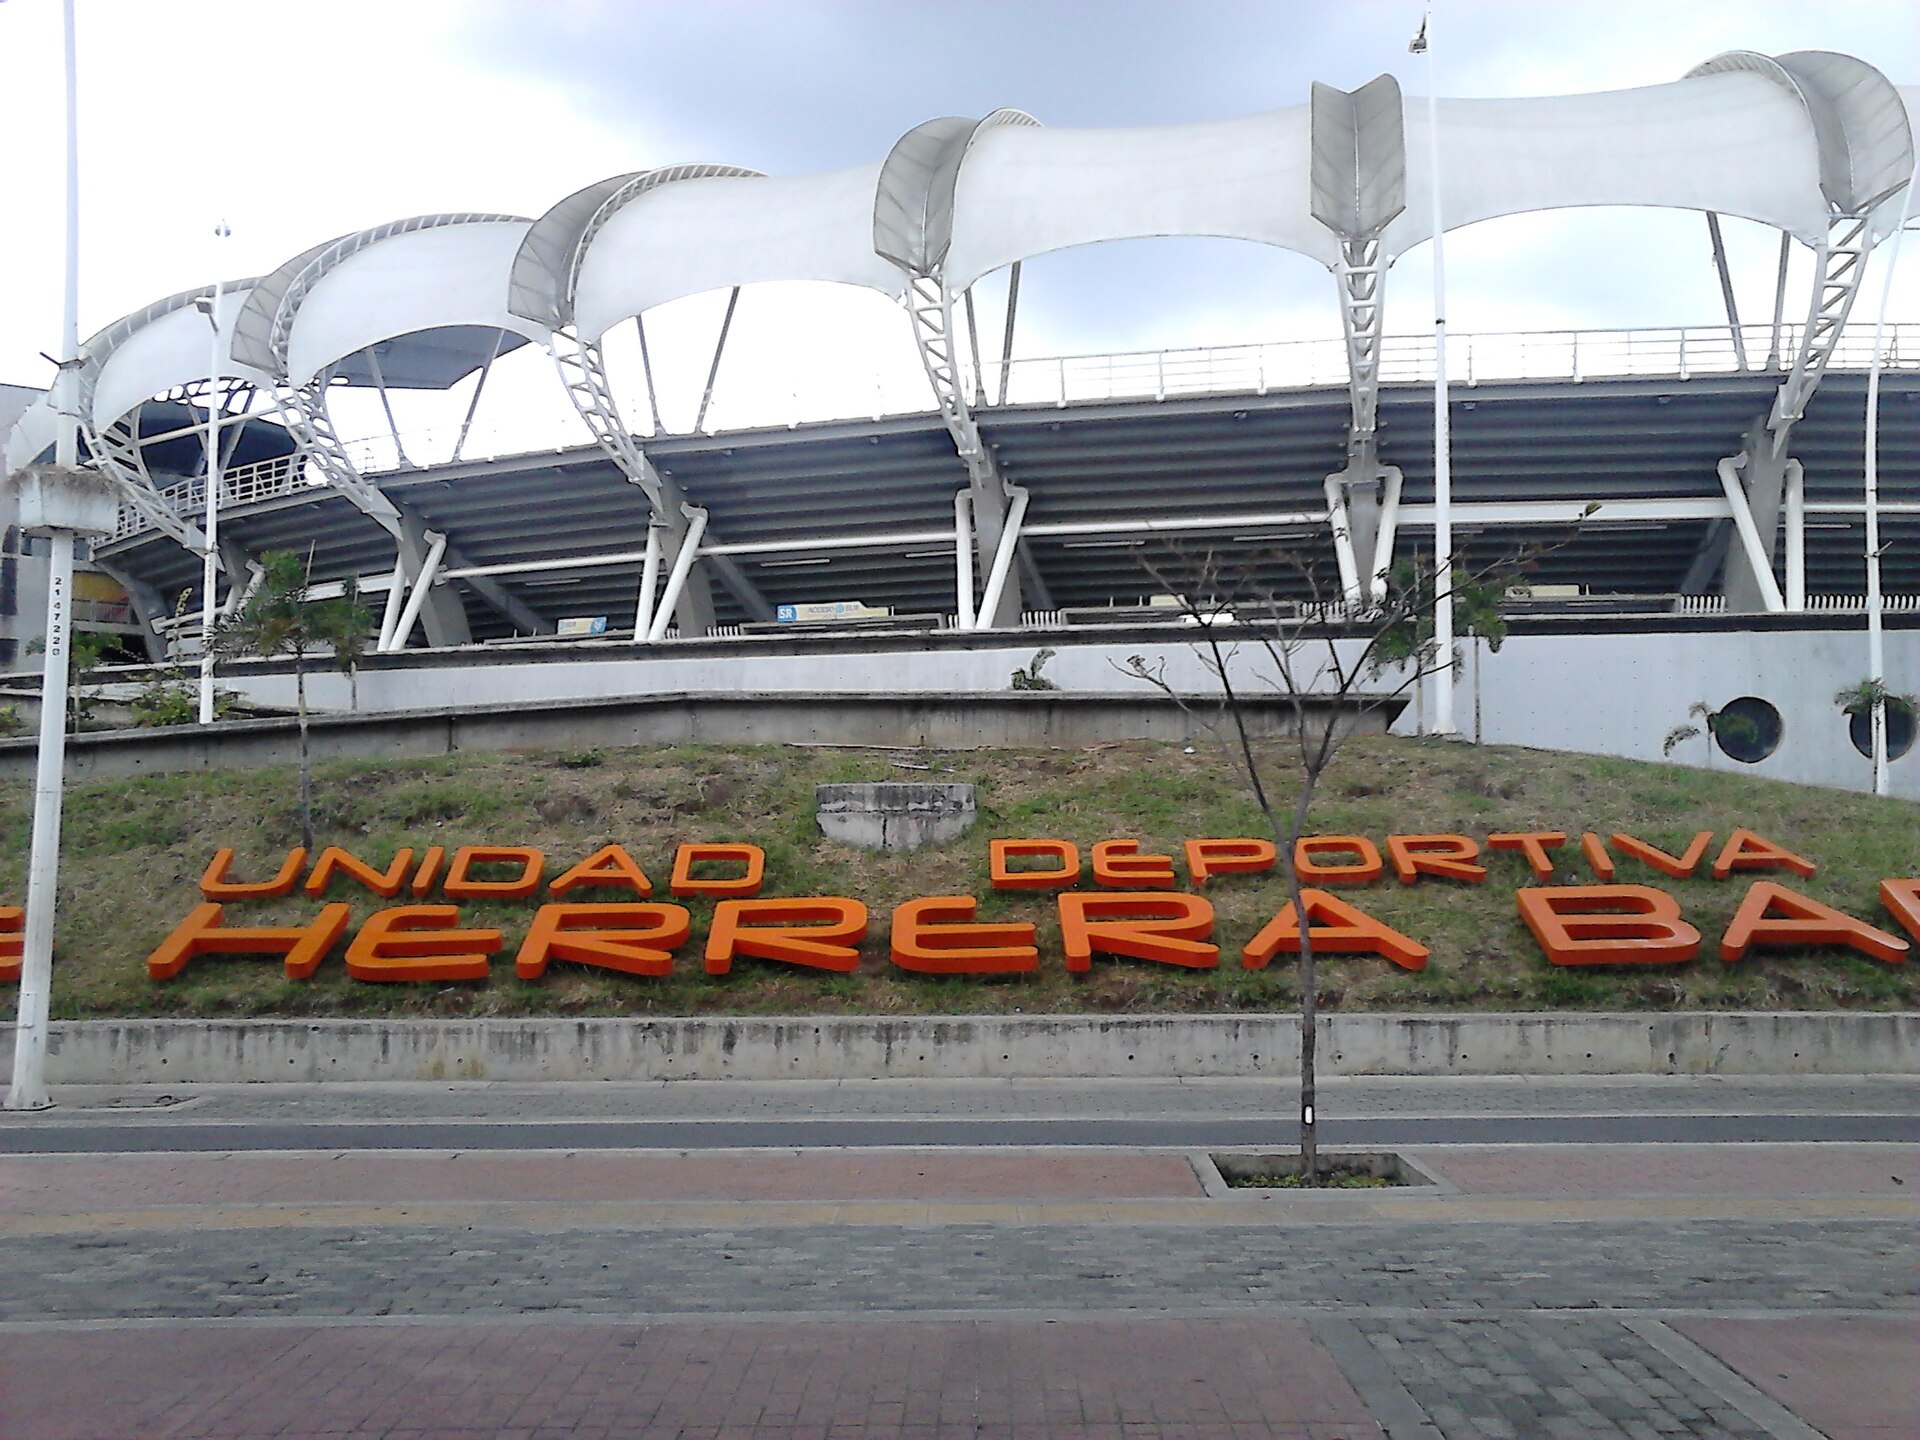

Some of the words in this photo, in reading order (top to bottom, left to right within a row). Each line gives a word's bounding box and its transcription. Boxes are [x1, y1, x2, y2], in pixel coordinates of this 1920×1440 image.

[200, 844, 764, 898] UNIDAD
[988, 829, 1815, 890] DEPORTIVA
[147, 888, 1428, 981] HERRERA
[1516, 879, 1920, 967] BA
